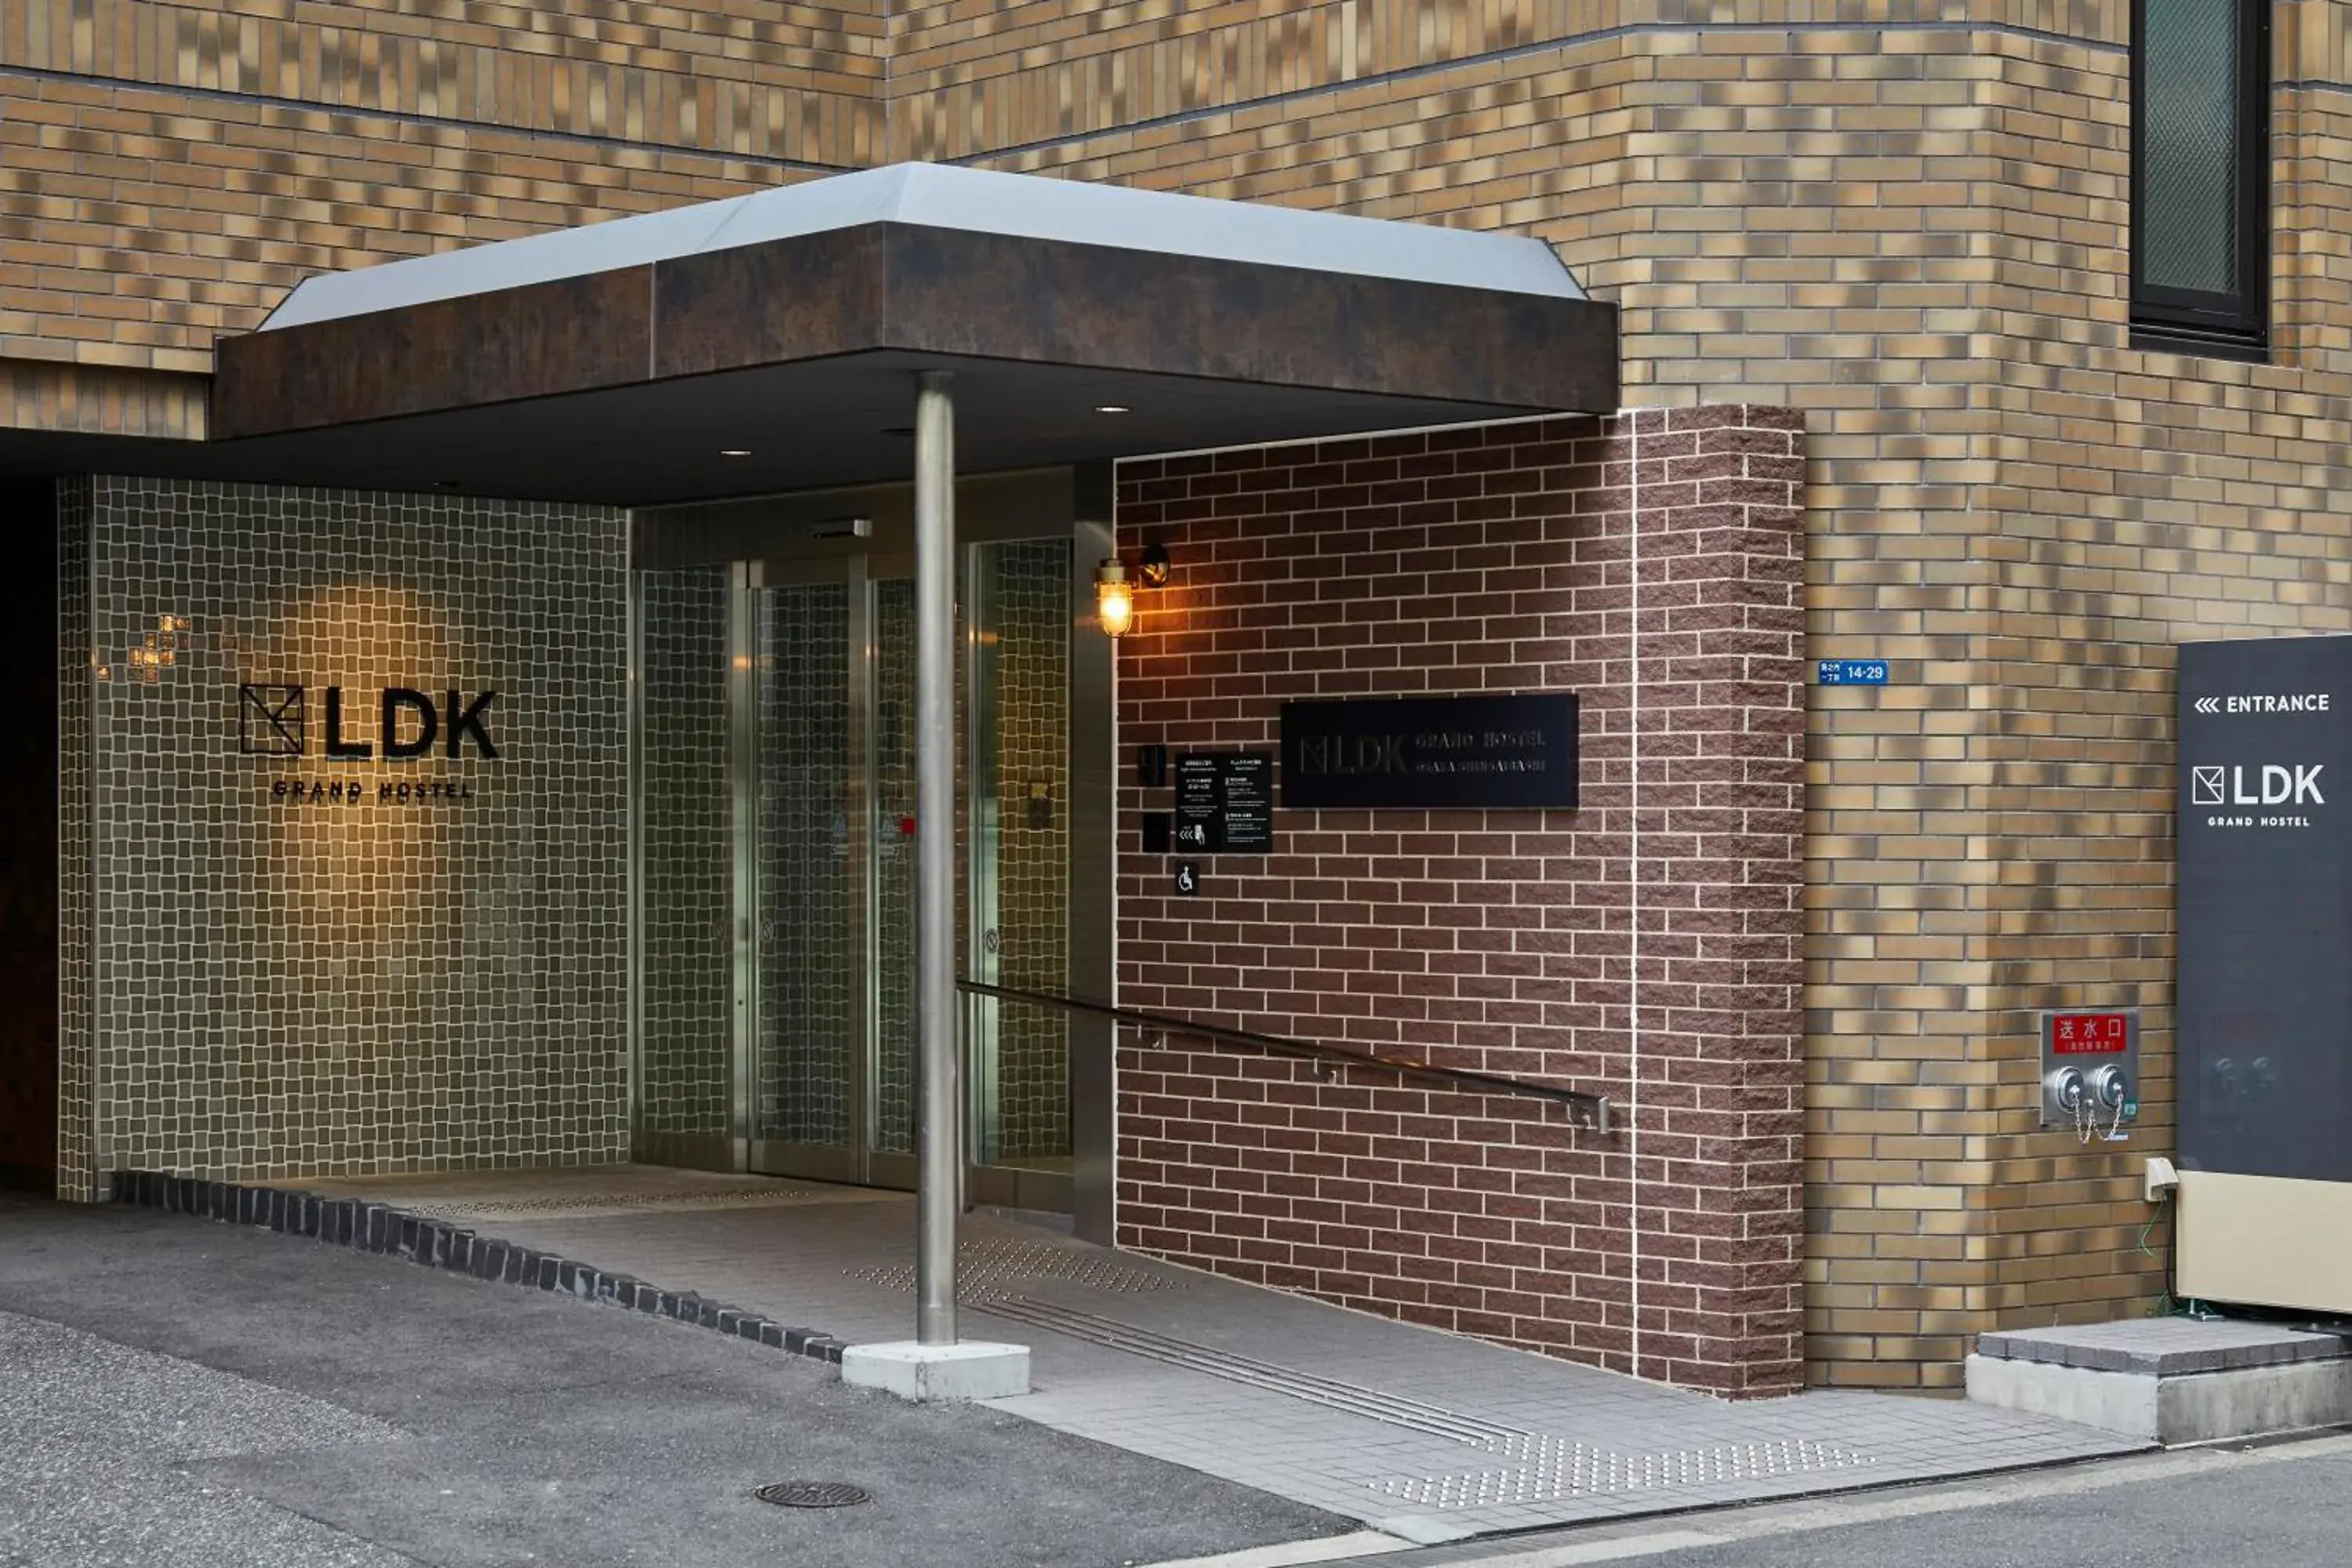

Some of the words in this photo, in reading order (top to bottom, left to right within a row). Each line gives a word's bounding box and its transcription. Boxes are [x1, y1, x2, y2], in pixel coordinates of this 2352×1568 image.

[1848, 666, 1883, 680] 14-29
[2227, 694, 2330, 713] ENTRANCE
[326, 686, 499, 759] LDK
[1334, 734, 1409, 775] LDK
[274, 780, 361, 797] GRAND
[380, 782, 472, 798] HOSTEL
[2234, 764, 2325, 804] LDK
[2208, 816, 2252, 826] GRAND
[2261, 816, 2310, 826] HOSTEL
[2060, 1018, 2121, 1039] 送水口
